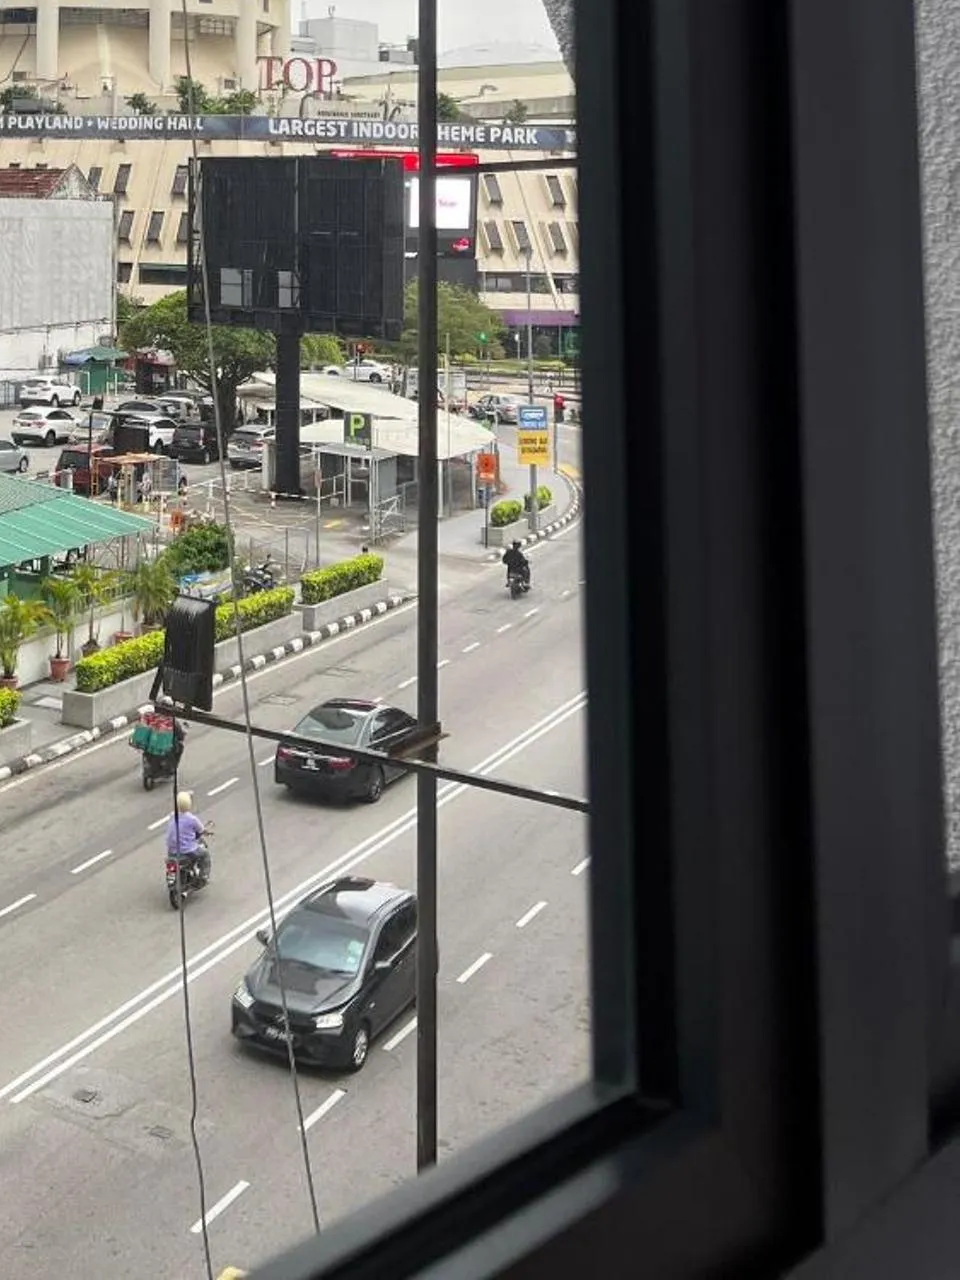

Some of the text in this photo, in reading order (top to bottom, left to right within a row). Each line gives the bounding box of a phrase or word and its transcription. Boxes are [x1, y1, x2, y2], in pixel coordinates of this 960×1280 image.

[255, 55, 337, 93] TOP
[7, 116, 82, 130] PLAYLAND
[97, 116, 163, 131] WEDDING
[268, 118, 538, 145] LARGEST INDOOR HEME PARK
[350, 414, 365, 437] P
